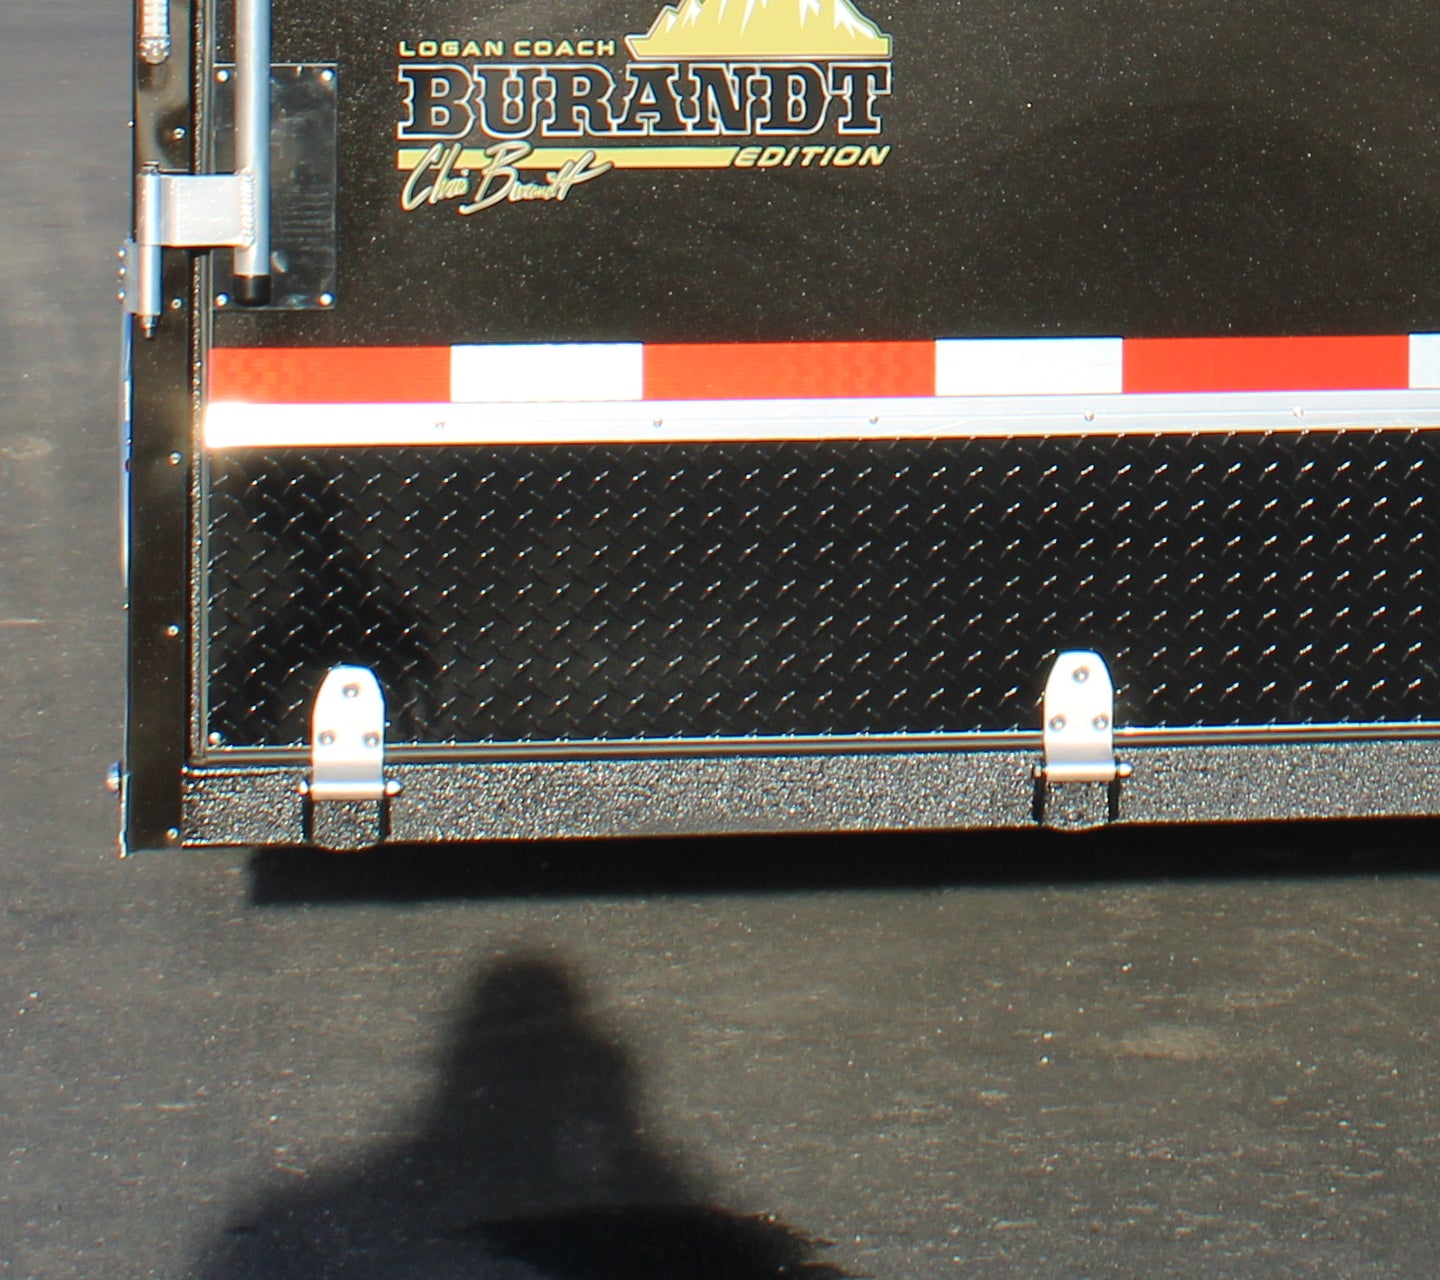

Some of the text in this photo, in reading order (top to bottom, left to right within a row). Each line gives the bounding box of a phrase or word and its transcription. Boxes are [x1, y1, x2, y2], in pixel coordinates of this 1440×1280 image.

[397, 40, 616, 58] LOGAN COACH
[396, 61, 893, 139] BURANDT
[732, 145, 892, 168] EDITION
